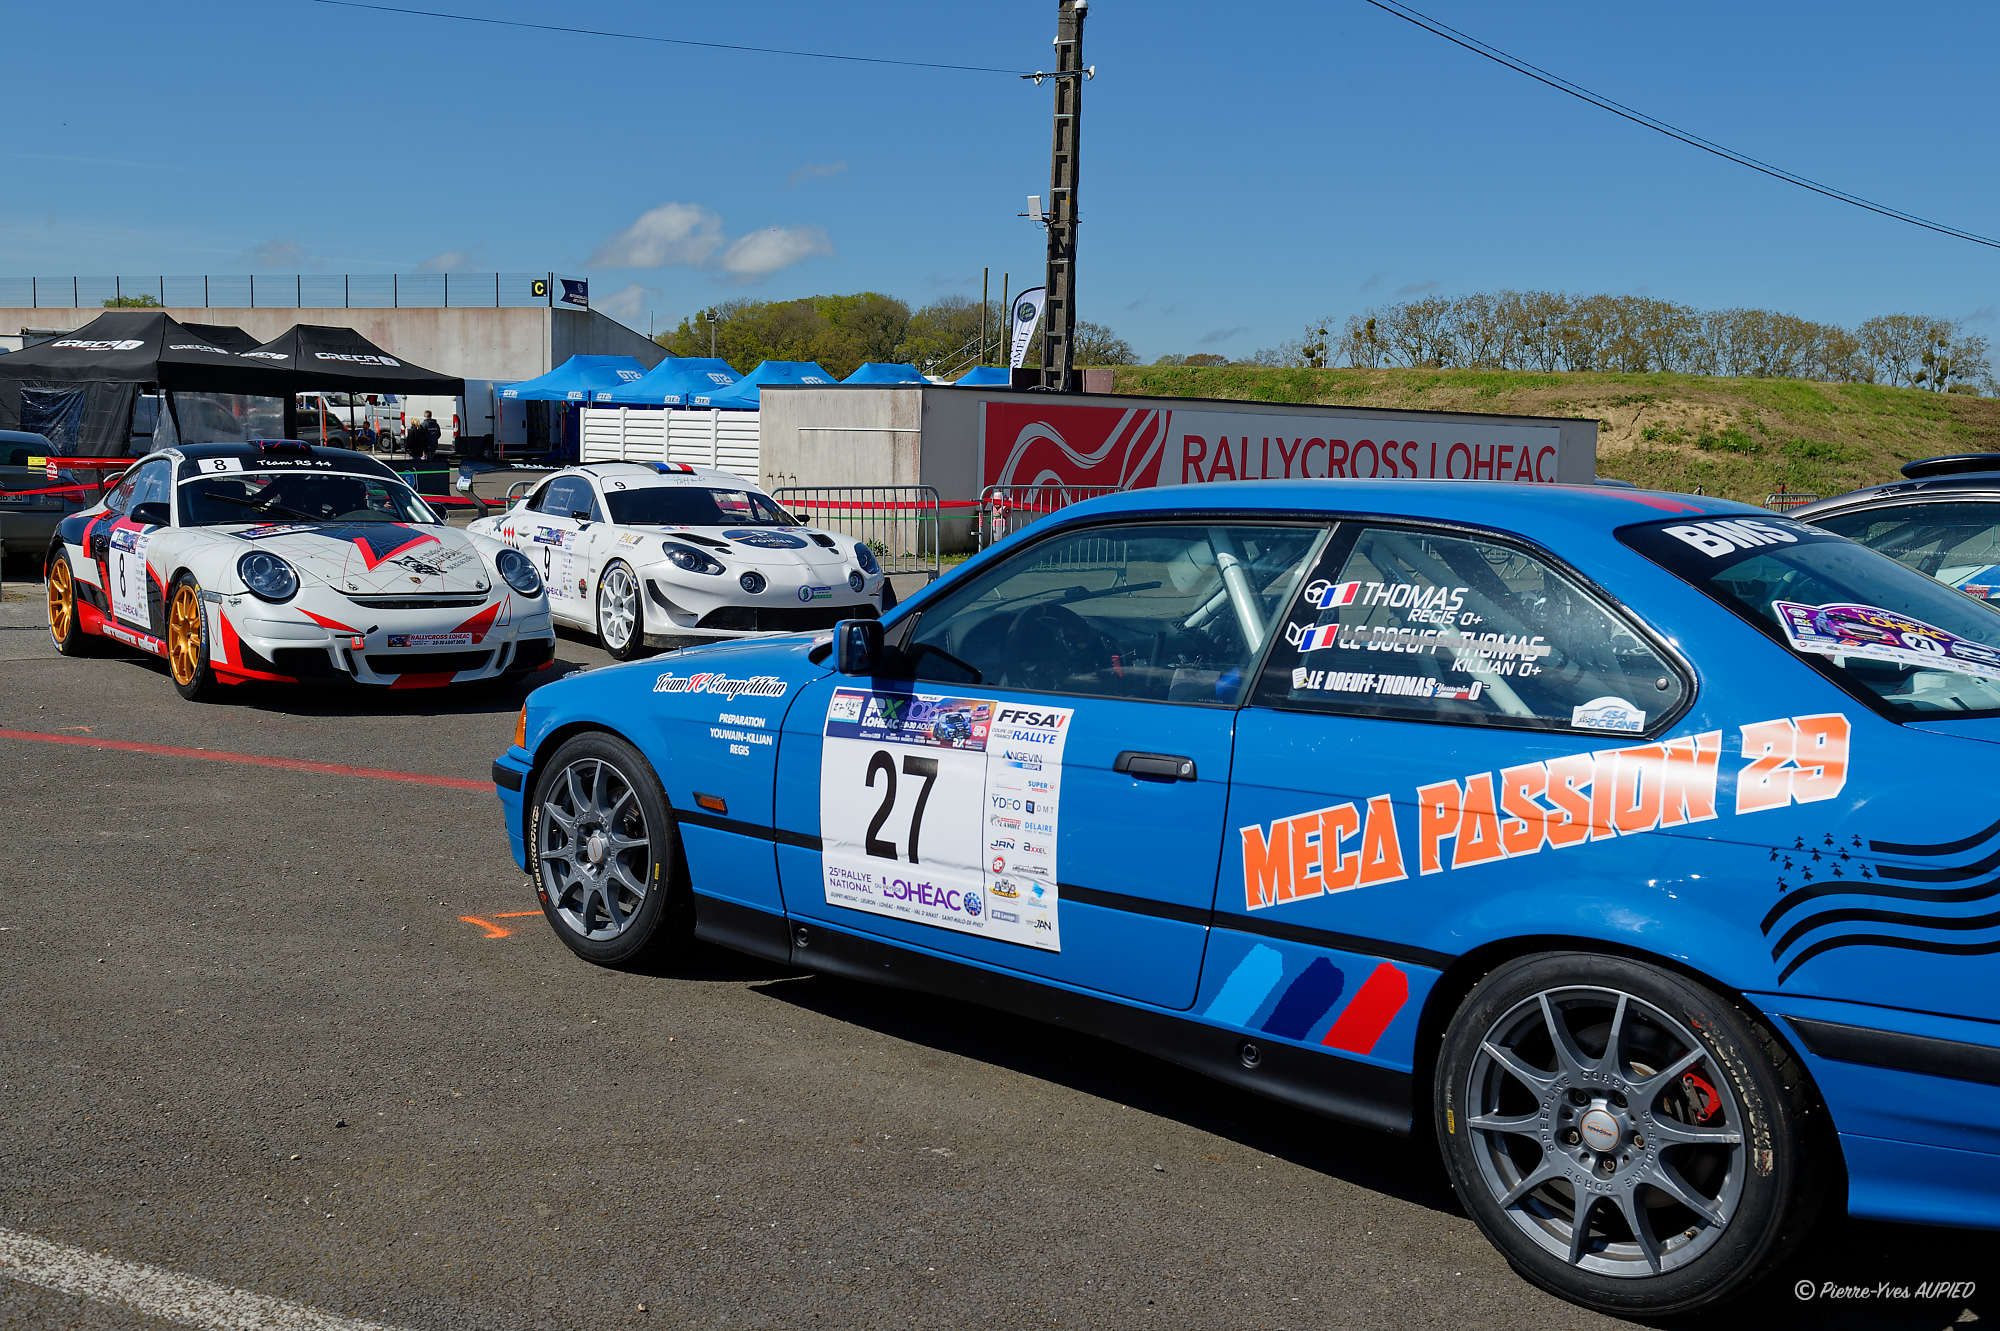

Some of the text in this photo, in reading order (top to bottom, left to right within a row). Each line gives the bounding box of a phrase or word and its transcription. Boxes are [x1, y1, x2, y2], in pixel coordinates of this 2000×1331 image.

[535, 282, 544, 294] C
[213, 459, 227, 471] 8
[1181, 434, 1417, 481] RALLYCROSS
[614, 481, 626, 490] 9
[1661, 519, 1799, 558] BMS
[543, 545, 551, 582] 9
[119, 552, 126, 598] 8
[1361, 581, 1469, 612] THOMAS
[1407, 608, 1459, 625] REGIS
[1451, 657, 1515, 676] KILLIAN
[653, 672, 687, 693] Team
[707, 673, 788, 701] Competition
[1307, 670, 1326, 690] LE
[1324, 671, 1437, 698] DOEUFF-THOMAS
[718, 713, 766, 728] PREPARATION
[997, 709, 1056, 728] FFSA
[709, 727, 773, 745] YOUWAIN-KILLIAN
[1011, 730, 1058, 745] RALLYE
[729, 744, 750, 756] REGIS
[1028, 780, 1048, 789] SUPER
[1416, 729, 1723, 877] PASSION
[1736, 713, 1851, 815] 29
[864, 749, 939, 865] 27
[841, 869, 872, 883] RALLYE
[829, 878, 873, 894] NATIONAL
[882, 876, 961, 911] LOHÉAC
